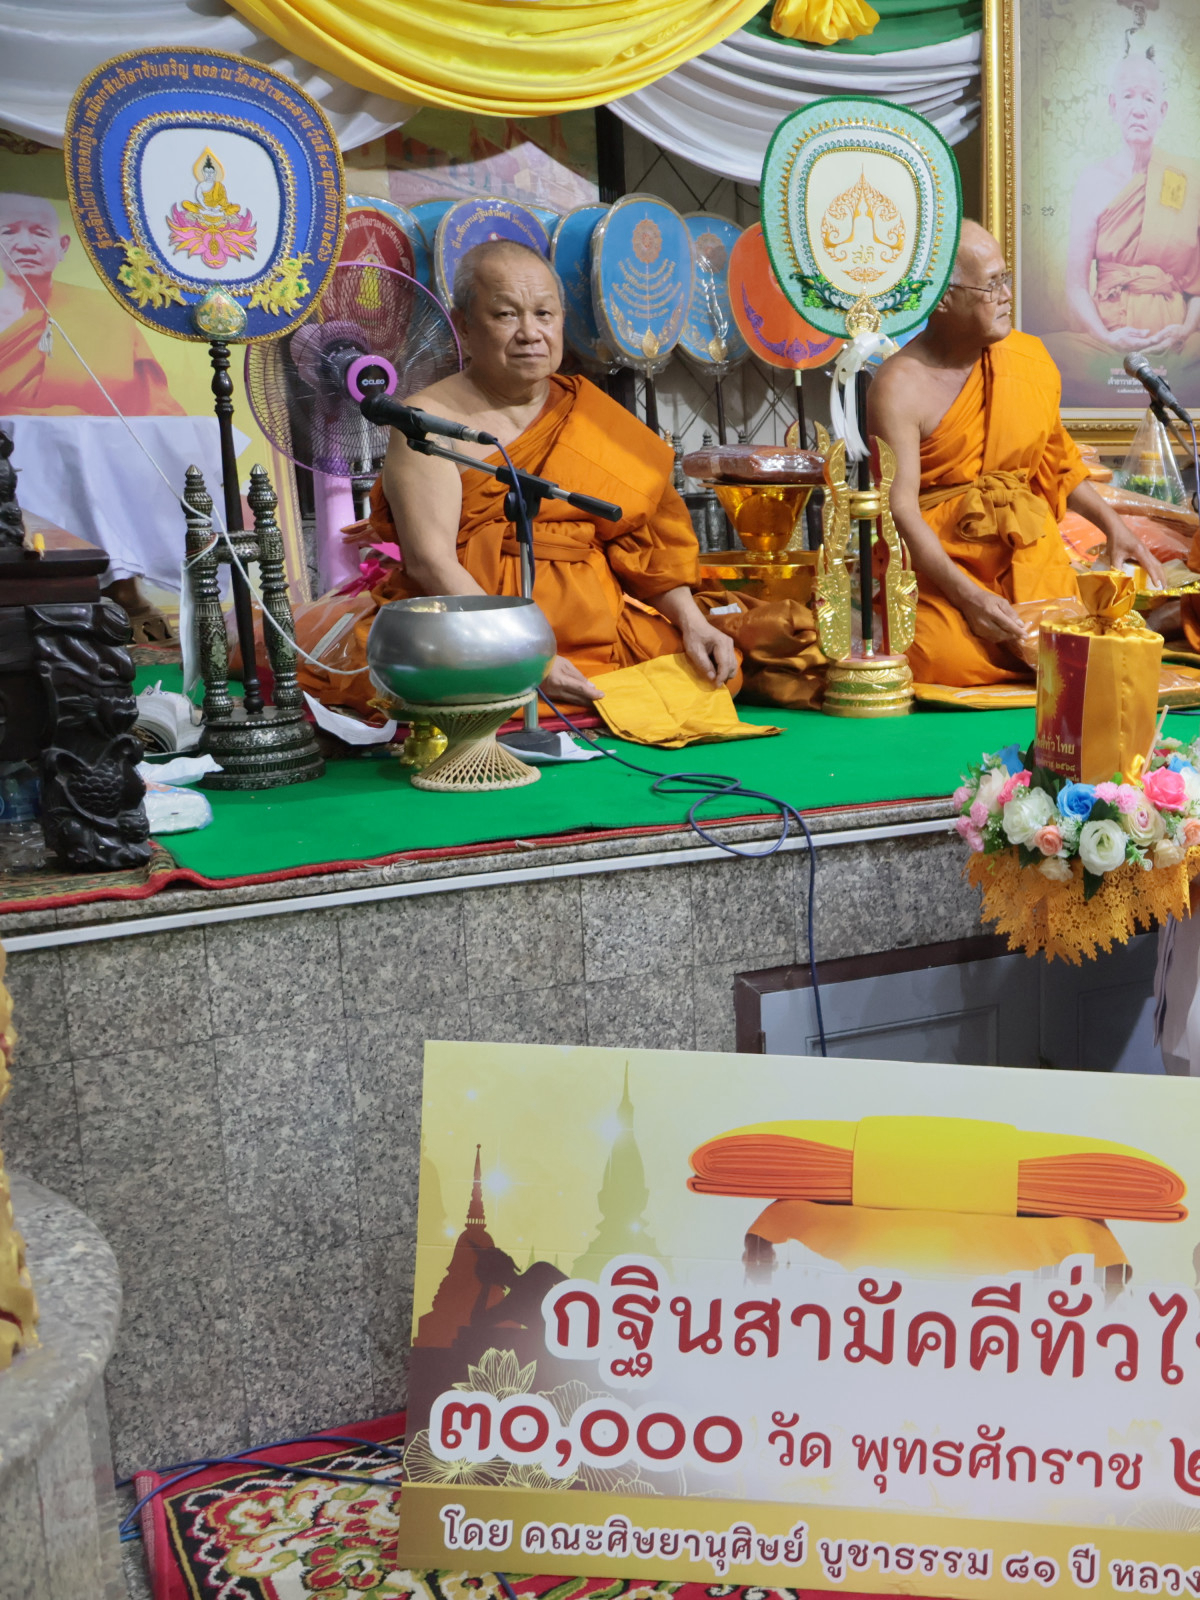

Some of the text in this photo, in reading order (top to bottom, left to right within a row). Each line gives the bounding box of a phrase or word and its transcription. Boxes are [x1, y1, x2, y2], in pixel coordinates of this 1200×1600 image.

[306, 129, 333, 153] วันที่
[440, 1402, 743, 1467] ๓๐,๐๐๐
[768, 1411, 832, 1468] วัด
[852, 1425, 1142, 1493] พุทธศักราช
[445, 1510, 507, 1546] โดย
[526, 1519, 803, 1570] คณะศิษยานุศิษย์
[821, 1541, 988, 1578] บูชาธรรม
[1006, 1555, 1056, 1582] ๘๑
[1073, 1549, 1096, 1584] ปี
